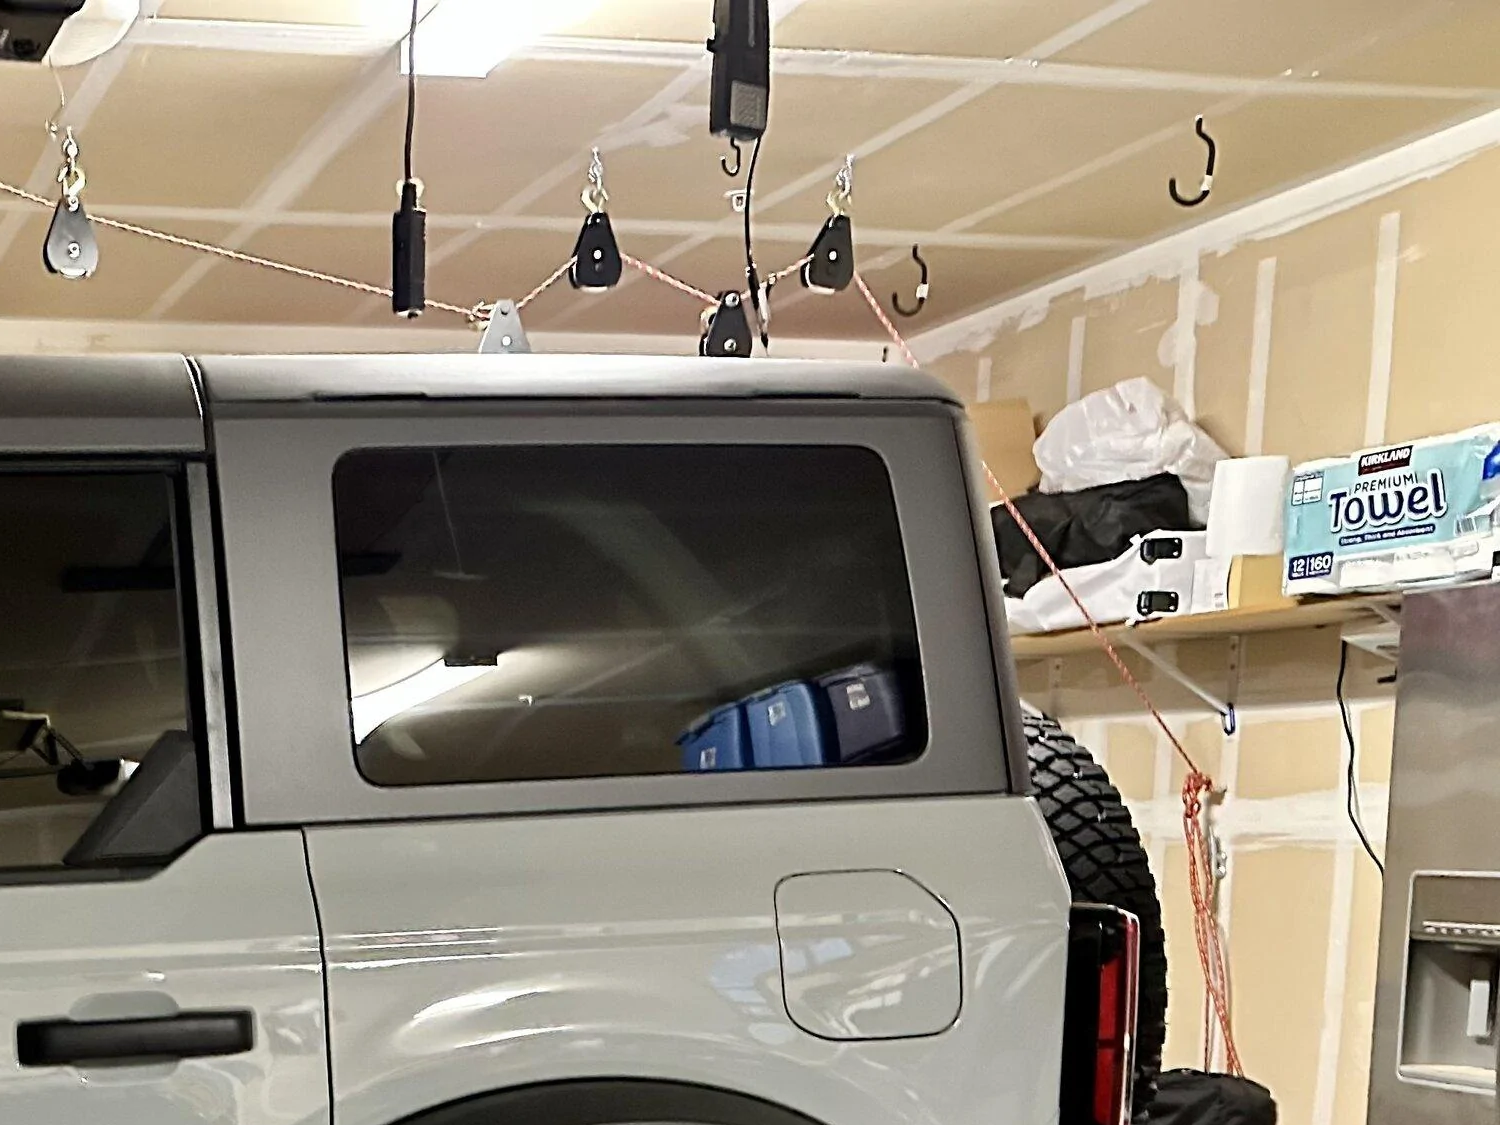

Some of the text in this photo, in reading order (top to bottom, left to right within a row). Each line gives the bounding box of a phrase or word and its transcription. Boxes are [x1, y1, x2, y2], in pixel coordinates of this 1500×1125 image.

[1361, 448, 1411, 467] KIRKLAND
[1353, 473, 1414, 493] PREMIUM
[1329, 472, 1444, 528] Towel
[1292, 554, 1331, 573] 12 160
